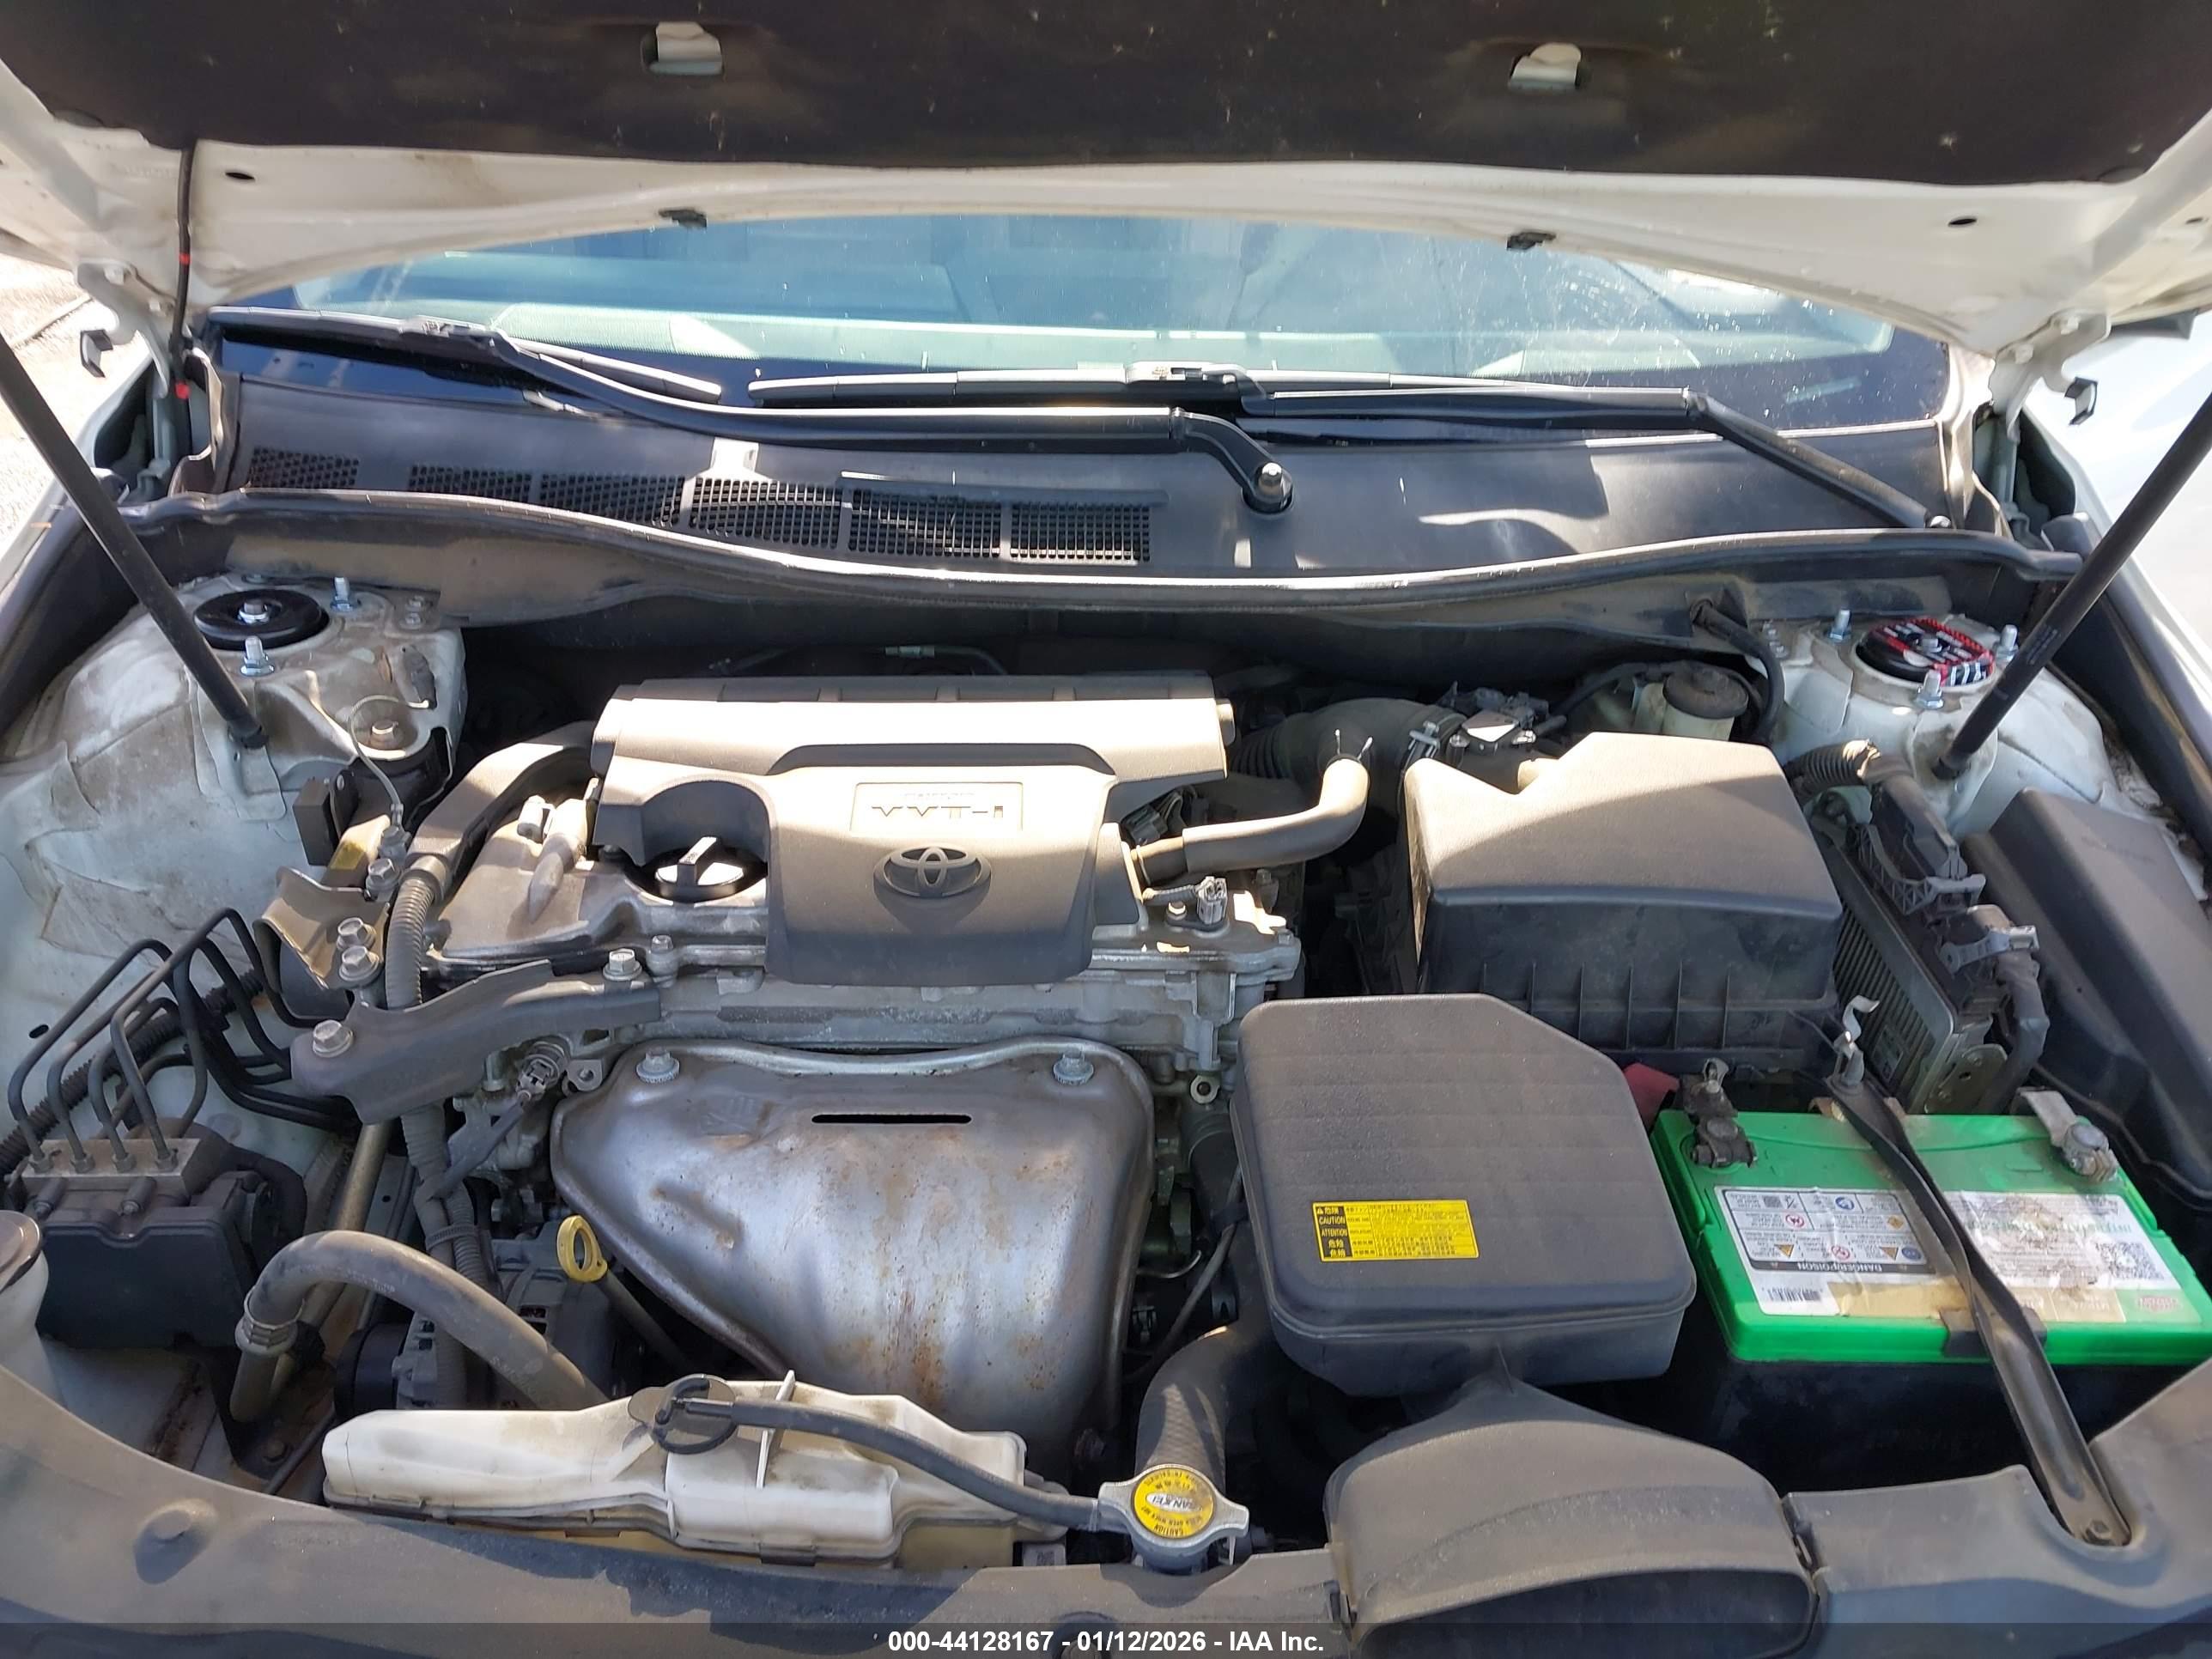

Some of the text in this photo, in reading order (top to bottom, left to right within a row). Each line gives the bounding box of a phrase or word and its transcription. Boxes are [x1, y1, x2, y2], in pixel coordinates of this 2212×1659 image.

[1319, 1215, 1346, 1225] CAUTION
[1321, 1227, 1348, 1237] ATTENTION
[1797, 1262, 1883, 1272] DANGER/POISON
